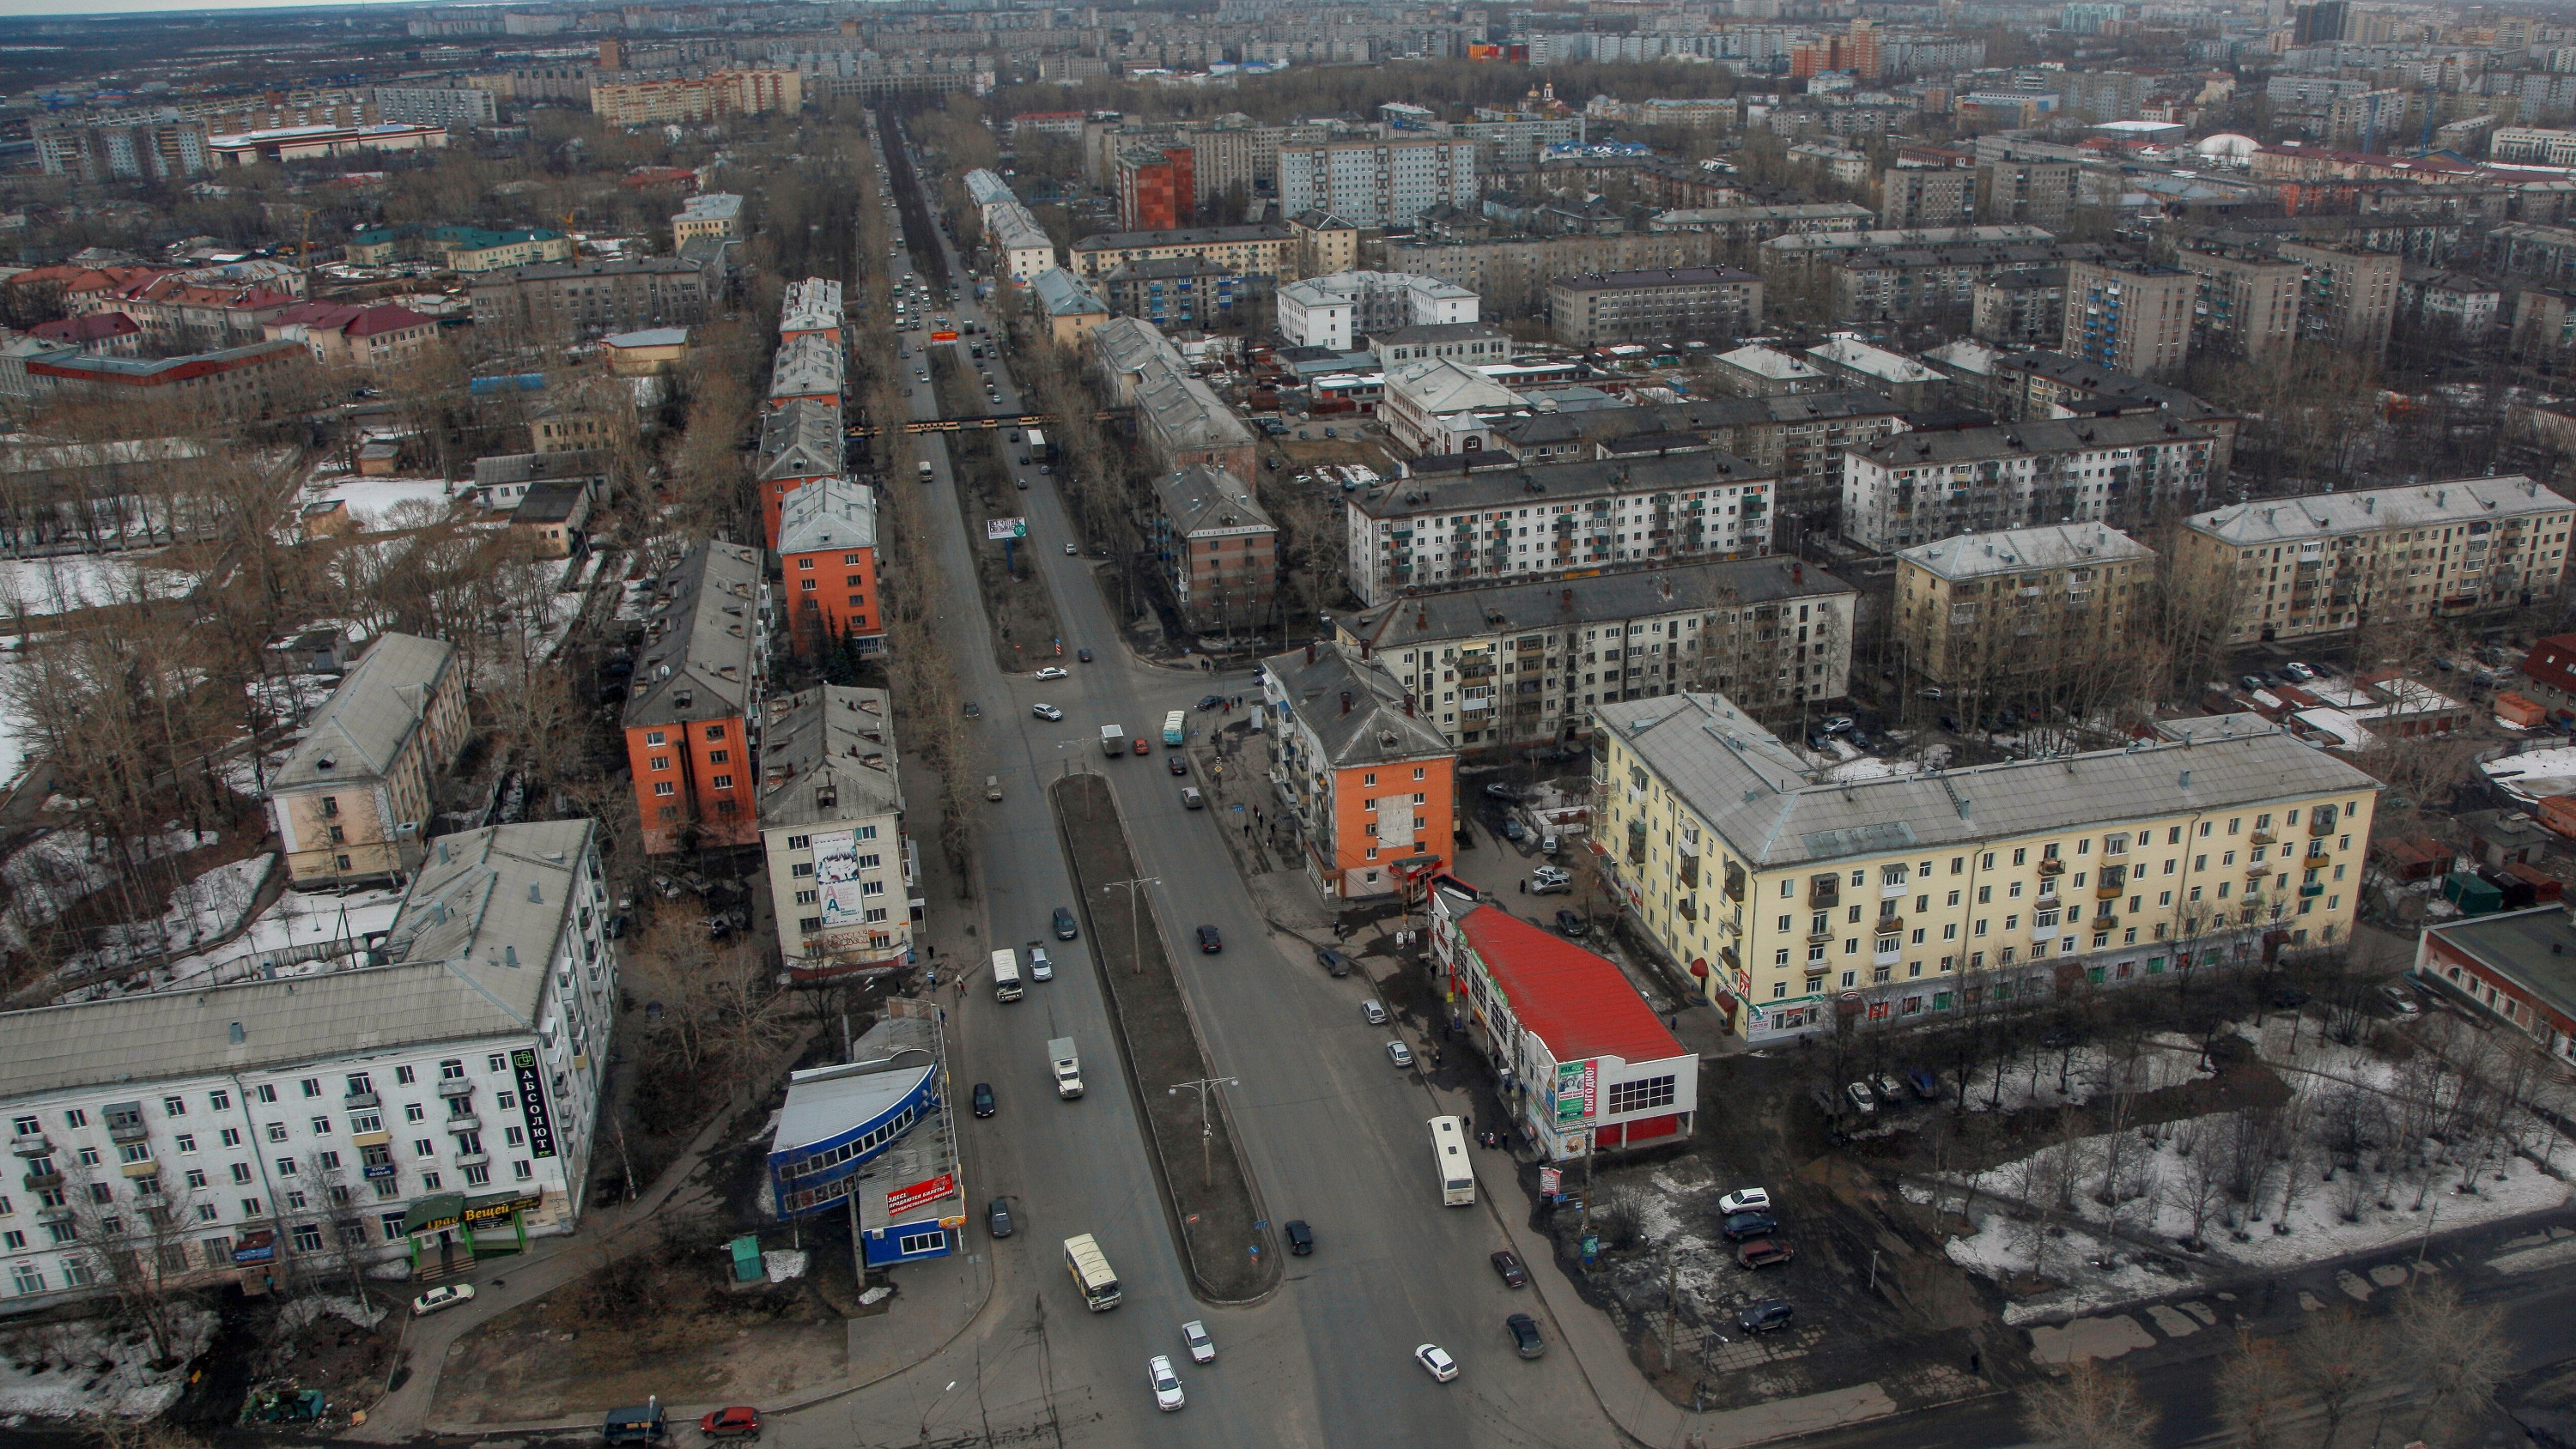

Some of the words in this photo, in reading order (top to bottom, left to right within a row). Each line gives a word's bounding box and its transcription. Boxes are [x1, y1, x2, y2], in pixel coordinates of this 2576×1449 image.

[1741, 983, 1749, 1000] 24
[1584, 1067, 1595, 1113] ВЫГОДНО!
[523, 1070, 547, 1149] АБСОЛЮТ
[888, 1192, 908, 1203] ЗДЕСЬ
[889, 1194, 921, 1209] ПРОДАЮТСЯ
[922, 1186, 945, 1197] БИЛЕТЫ
[890, 1197, 933, 1214] ГОСУДАРСТВЕННЫХ
[933, 1189, 953, 1199] ЛОТЕРЕЙ
[465, 1203, 510, 1221] Вещей
